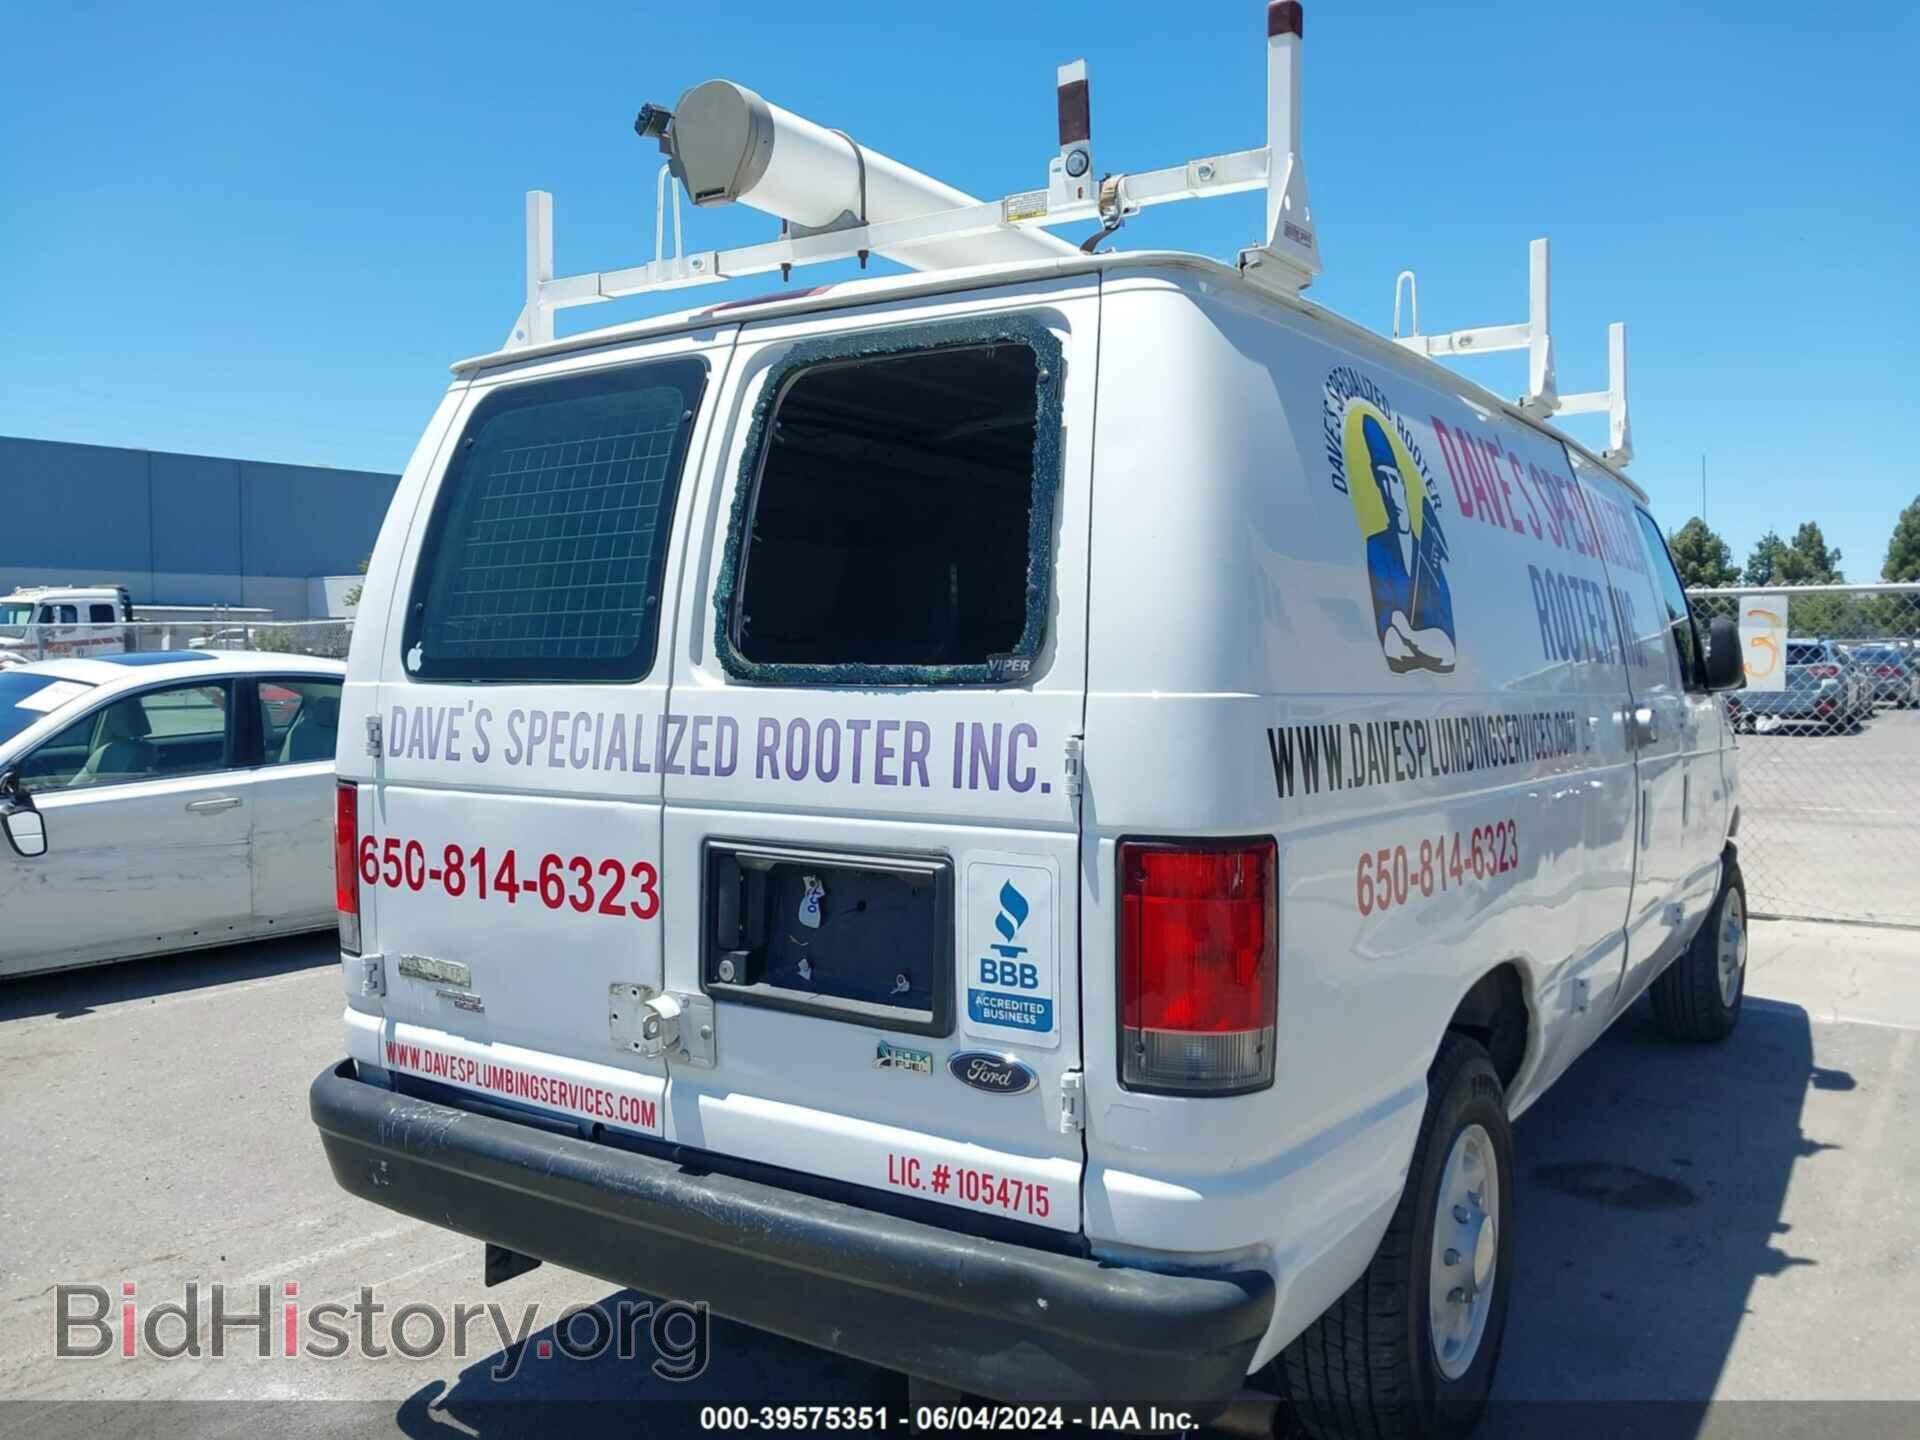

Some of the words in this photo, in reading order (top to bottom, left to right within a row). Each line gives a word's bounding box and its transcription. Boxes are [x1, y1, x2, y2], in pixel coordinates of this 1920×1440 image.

[1396, 415, 1442, 509] ROOTER
[1431, 415, 1543, 541] DAVE'S
[1527, 564, 1616, 666] ROOTER
[989, 659, 1031, 672] VIPER
[388, 699, 493, 764] DAVE'S
[503, 708, 740, 777] SPECIALIZED
[755, 716, 931, 788] ROOTER
[952, 721, 1052, 794] INC.
[360, 834, 660, 920] 650-814-6323
[1356, 818, 1519, 916] 650-814-6323
[975, 995, 1045, 1014] ACCREDITED
[980, 957, 1039, 989] BBB
[983, 1007, 1037, 1025] BUSINESS
[385, 1039, 656, 1129] WWW.DAVESPLUMBINGSERVICES.COM
[966, 1058, 1013, 1087] Ford
[888, 1153, 927, 1191] LIC.
